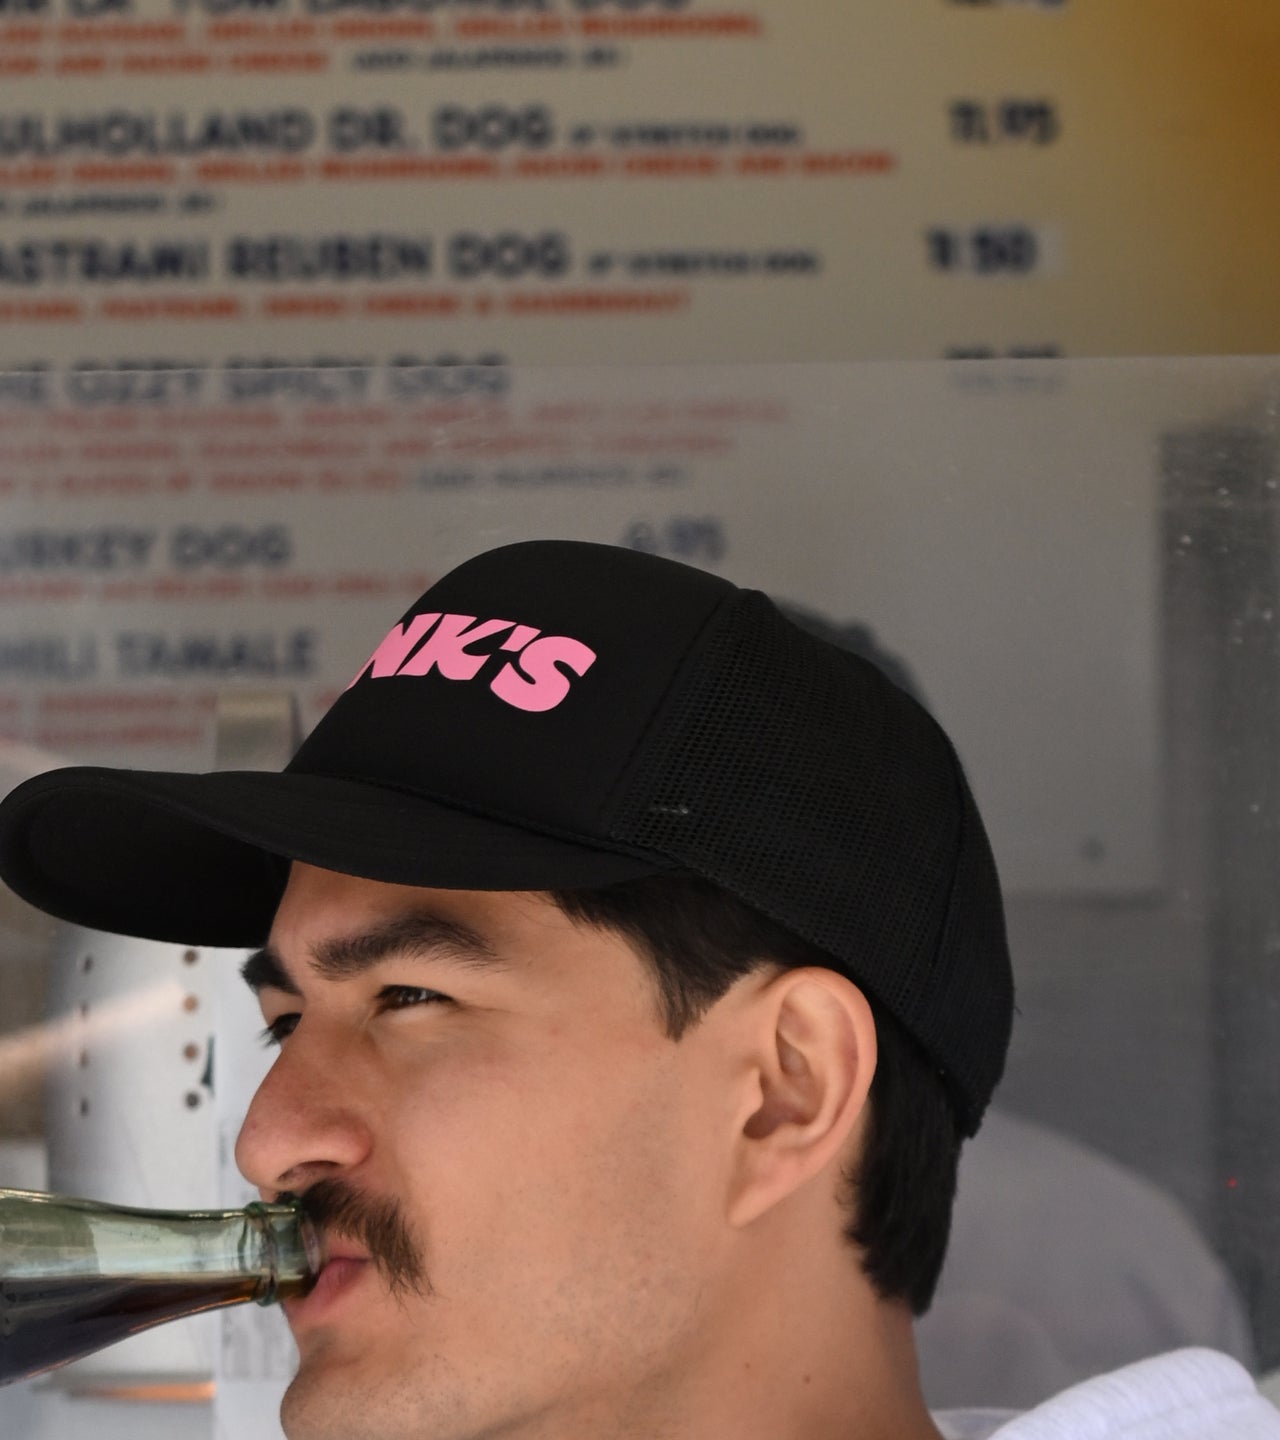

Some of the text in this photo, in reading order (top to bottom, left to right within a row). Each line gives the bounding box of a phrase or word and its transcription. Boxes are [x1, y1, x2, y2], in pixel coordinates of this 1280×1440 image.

[432, 105, 555, 152] DOG
[225, 235, 432, 282] REUBEN
[448, 231, 571, 280] DOG
[387, 351, 509, 400] DOG
[170, 525, 292, 573] DOG
[117, 629, 316, 679] TAMALE
[346, 612, 598, 712] NK'S
